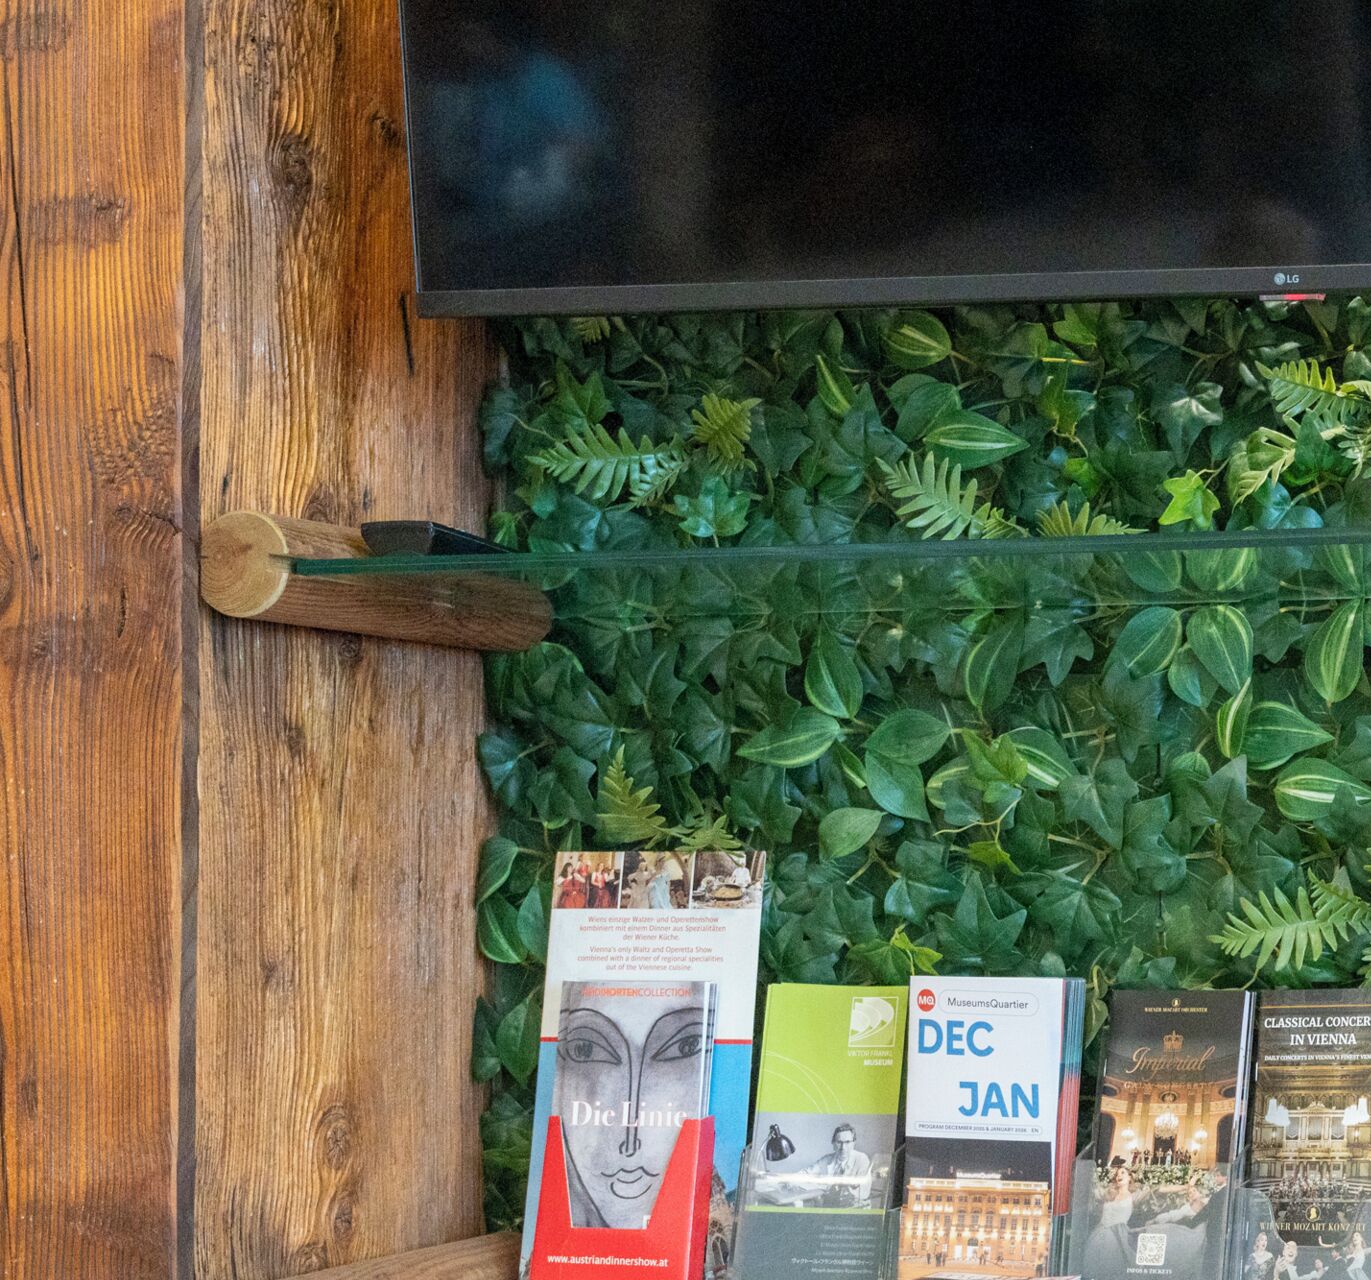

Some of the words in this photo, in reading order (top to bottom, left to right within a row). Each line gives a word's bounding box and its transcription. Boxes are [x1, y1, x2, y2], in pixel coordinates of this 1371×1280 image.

[1286, 274, 1300, 284] LG
[685, 925, 727, 934] Spezialitäten
[617, 946, 631, 955] only
[665, 946, 694, 955] Operetta
[661, 955, 687, 964] regional
[617, 963, 625, 971] of
[638, 963, 668, 971] Viennese
[918, 995, 935, 1006] MQ
[947, 996, 1029, 1010] MuseumsQuartier
[1264, 1016, 1324, 1029] CLASSICAL
[917, 1018, 995, 1058] DEC
[1290, 1033, 1305, 1046] IN
[1307, 1033, 1357, 1045] VIENNA
[1125, 1044, 1216, 1082] Imperial
[958, 1081, 1040, 1119] JAN
[570, 1101, 616, 1126] Die
[621, 1101, 688, 1127] Linie
[1293, 1222, 1325, 1231] MOZART
[547, 1255, 668, 1268] www.austriandinnershow.at
